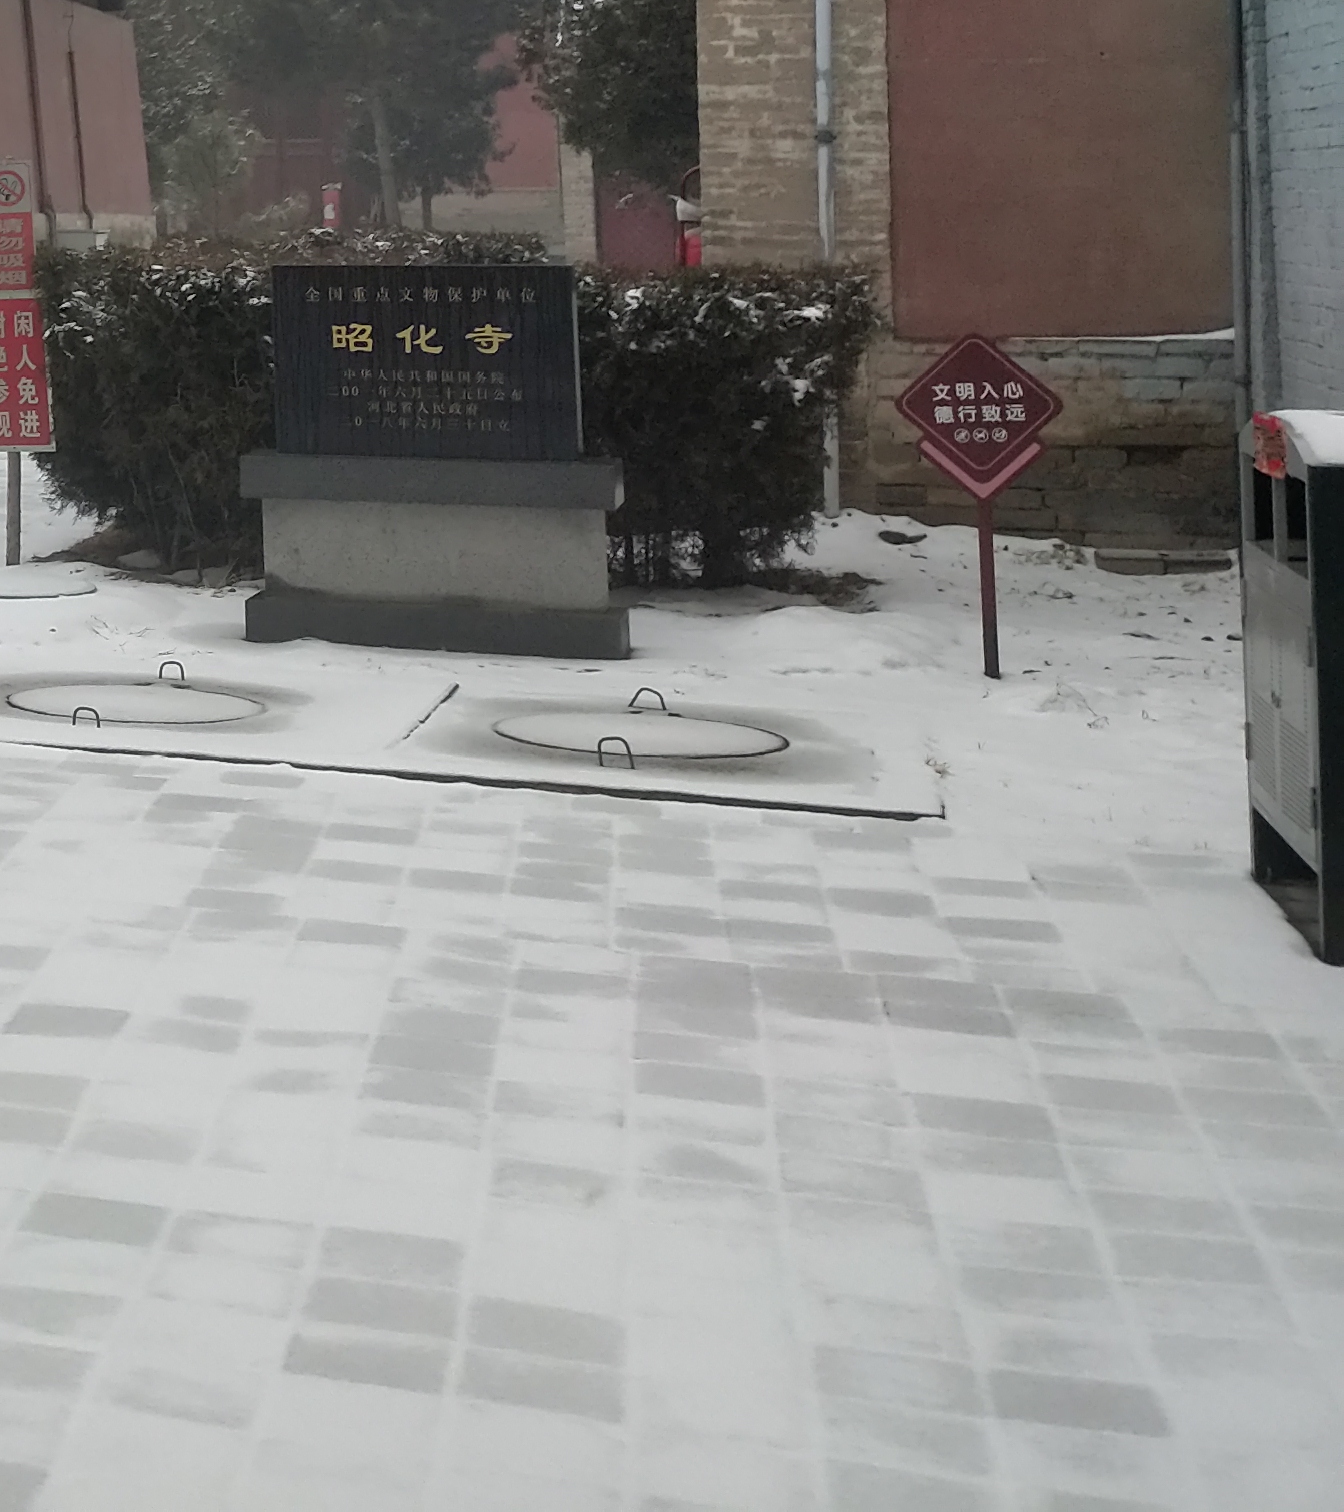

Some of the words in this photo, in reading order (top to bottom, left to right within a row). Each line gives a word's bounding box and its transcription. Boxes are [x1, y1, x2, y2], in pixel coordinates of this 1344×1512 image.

[305, 286, 537, 304] 全国重点文物保护单位
[331, 323, 513, 354] 昭化寺
[14, 311, 41, 438] 闲人免进
[343, 368, 505, 385] 中华人民共和国国务院
[931, 381, 1024, 402] 文明入心
[368, 401, 480, 416] 河北省人民政府
[933, 404, 1027, 424] 德行致远
